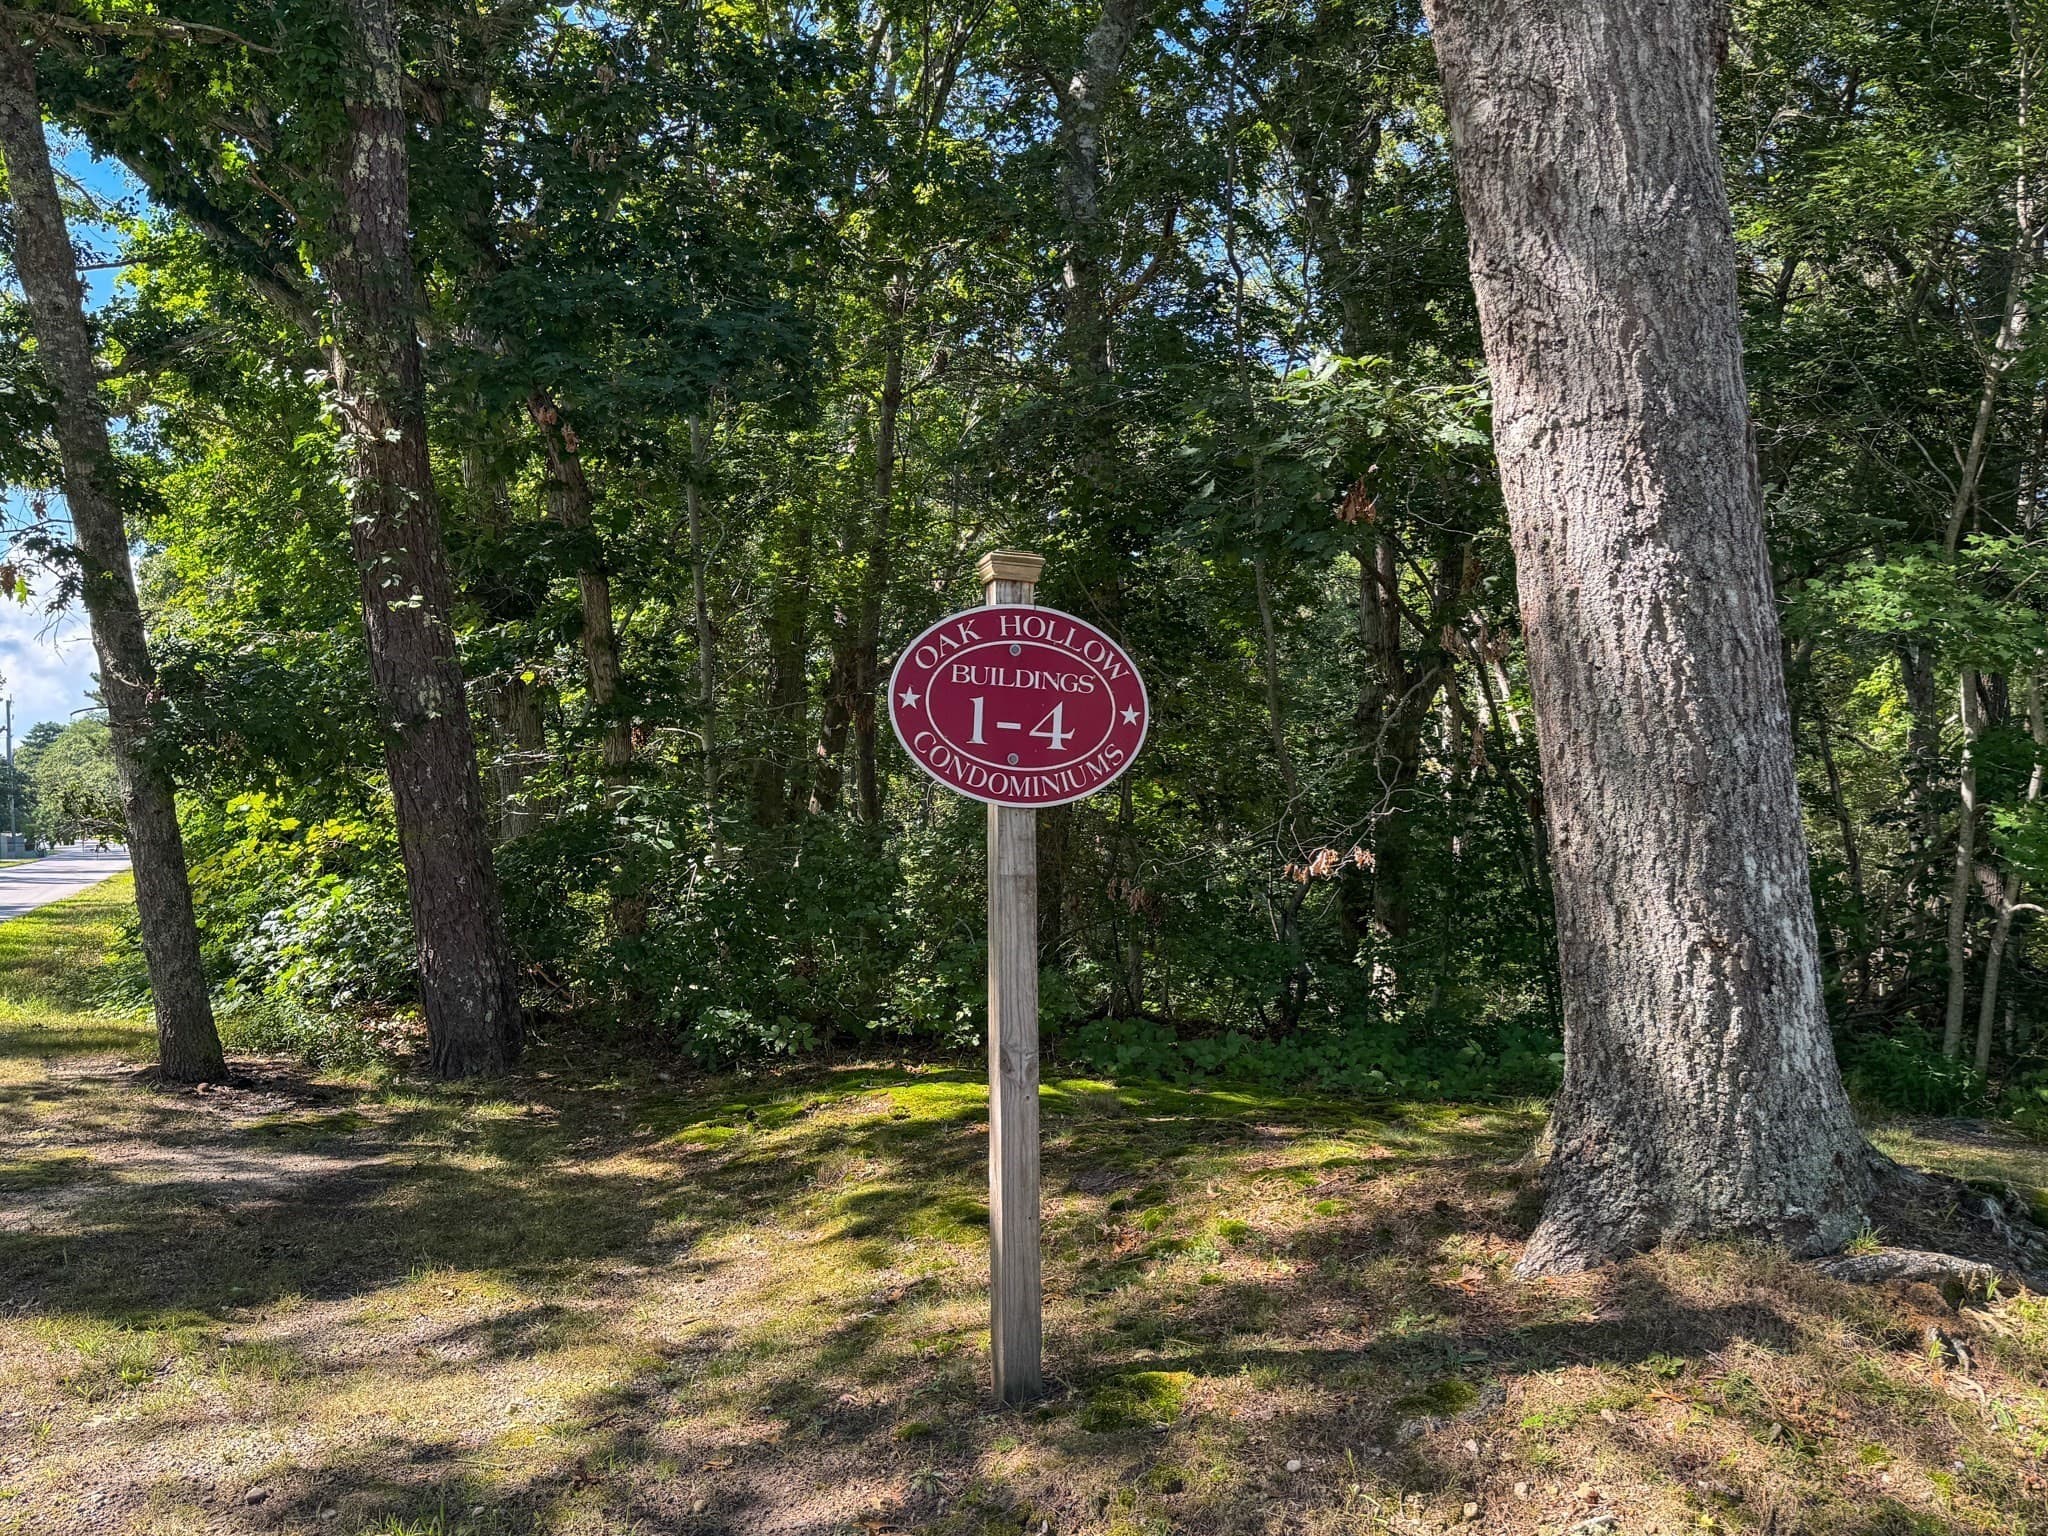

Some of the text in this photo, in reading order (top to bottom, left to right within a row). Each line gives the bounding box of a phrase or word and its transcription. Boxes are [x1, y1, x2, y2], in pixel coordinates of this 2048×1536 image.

[915, 615, 1131, 681] OAK HOLLOW
[951, 664, 1096, 694] BUILDINGS
[913, 731, 1124, 798] CONDOMINIUMS
